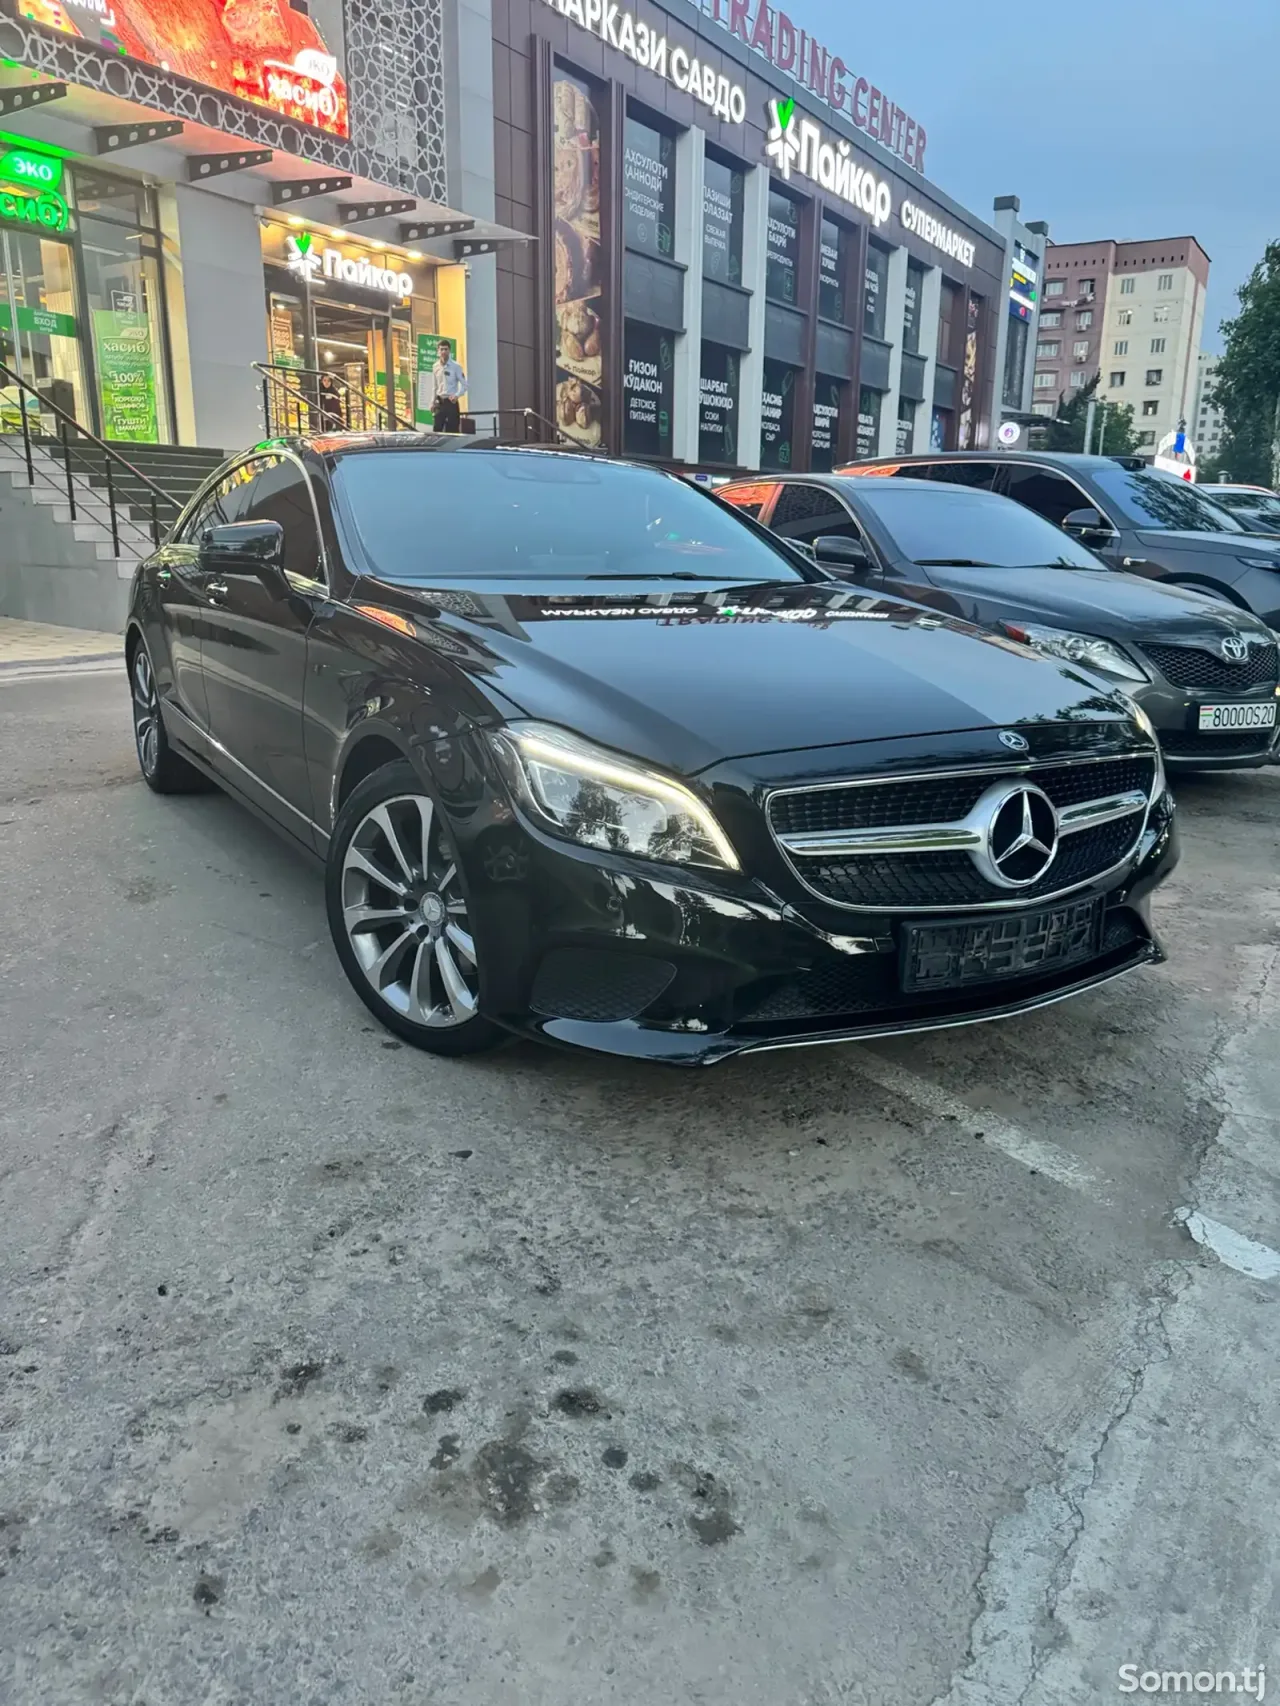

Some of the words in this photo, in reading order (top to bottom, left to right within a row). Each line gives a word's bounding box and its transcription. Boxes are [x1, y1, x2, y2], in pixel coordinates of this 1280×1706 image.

[546, 0, 667, 78] АРКАЗИ
[671, 47, 746, 124] САВДО
[852, 77, 927, 173] CENTER
[12, 156, 53, 181] ЭКО
[625, 147, 668, 180] АҲСУЛОТИ
[800, 119, 892, 227] Пайкар
[0, 193, 58, 227] сиб
[704, 201, 733, 224] ОЛАЗЗАТ
[901, 199, 976, 269] СУПЕРМАРКЕТ
[323, 248, 413, 298] Пайкар
[34, 316, 57, 329] ВХОД
[104, 341, 145, 353] хасиб
[113, 372, 143, 383] 100%
[630, 397, 656, 411] ДЕТСКОЕ
[699, 391, 733, 410] ӮШОКИҲО
[630, 411, 656, 423] ПИТАНИЕ
[705, 411, 719, 421] СОКИ
[700, 422, 723, 433] НАПИТКИ
[765, 432, 776, 441] СЫР
